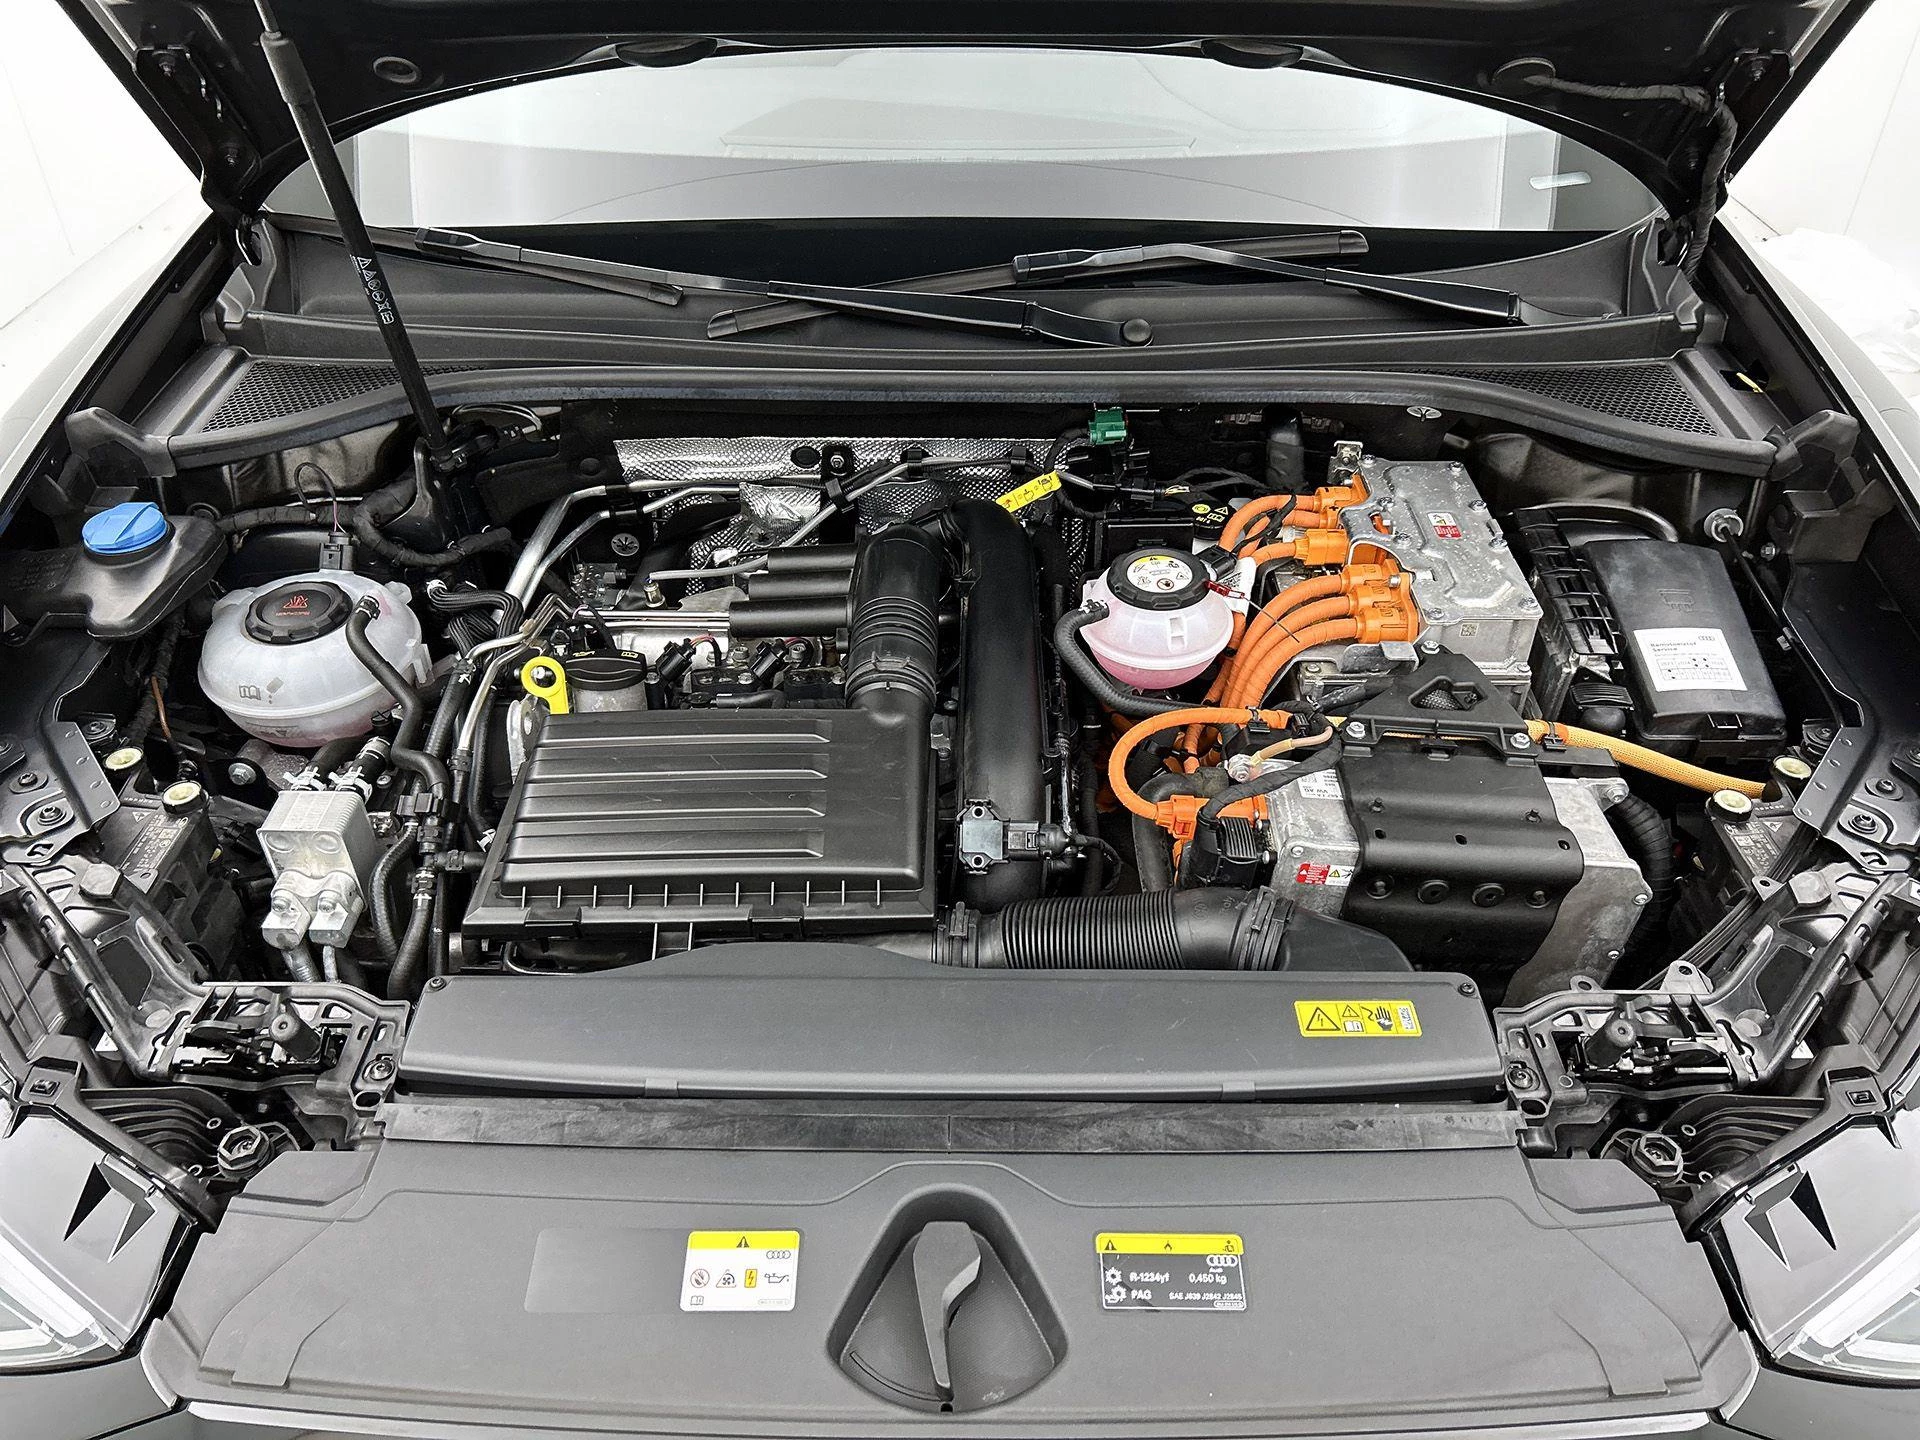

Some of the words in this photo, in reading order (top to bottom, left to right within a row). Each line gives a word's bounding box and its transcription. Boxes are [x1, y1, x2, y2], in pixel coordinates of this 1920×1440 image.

[1129, 1272, 1170, 1284] R-1234yf
[1215, 1273, 1228, 1285] kg
[1131, 1289, 1152, 1300] PAG
